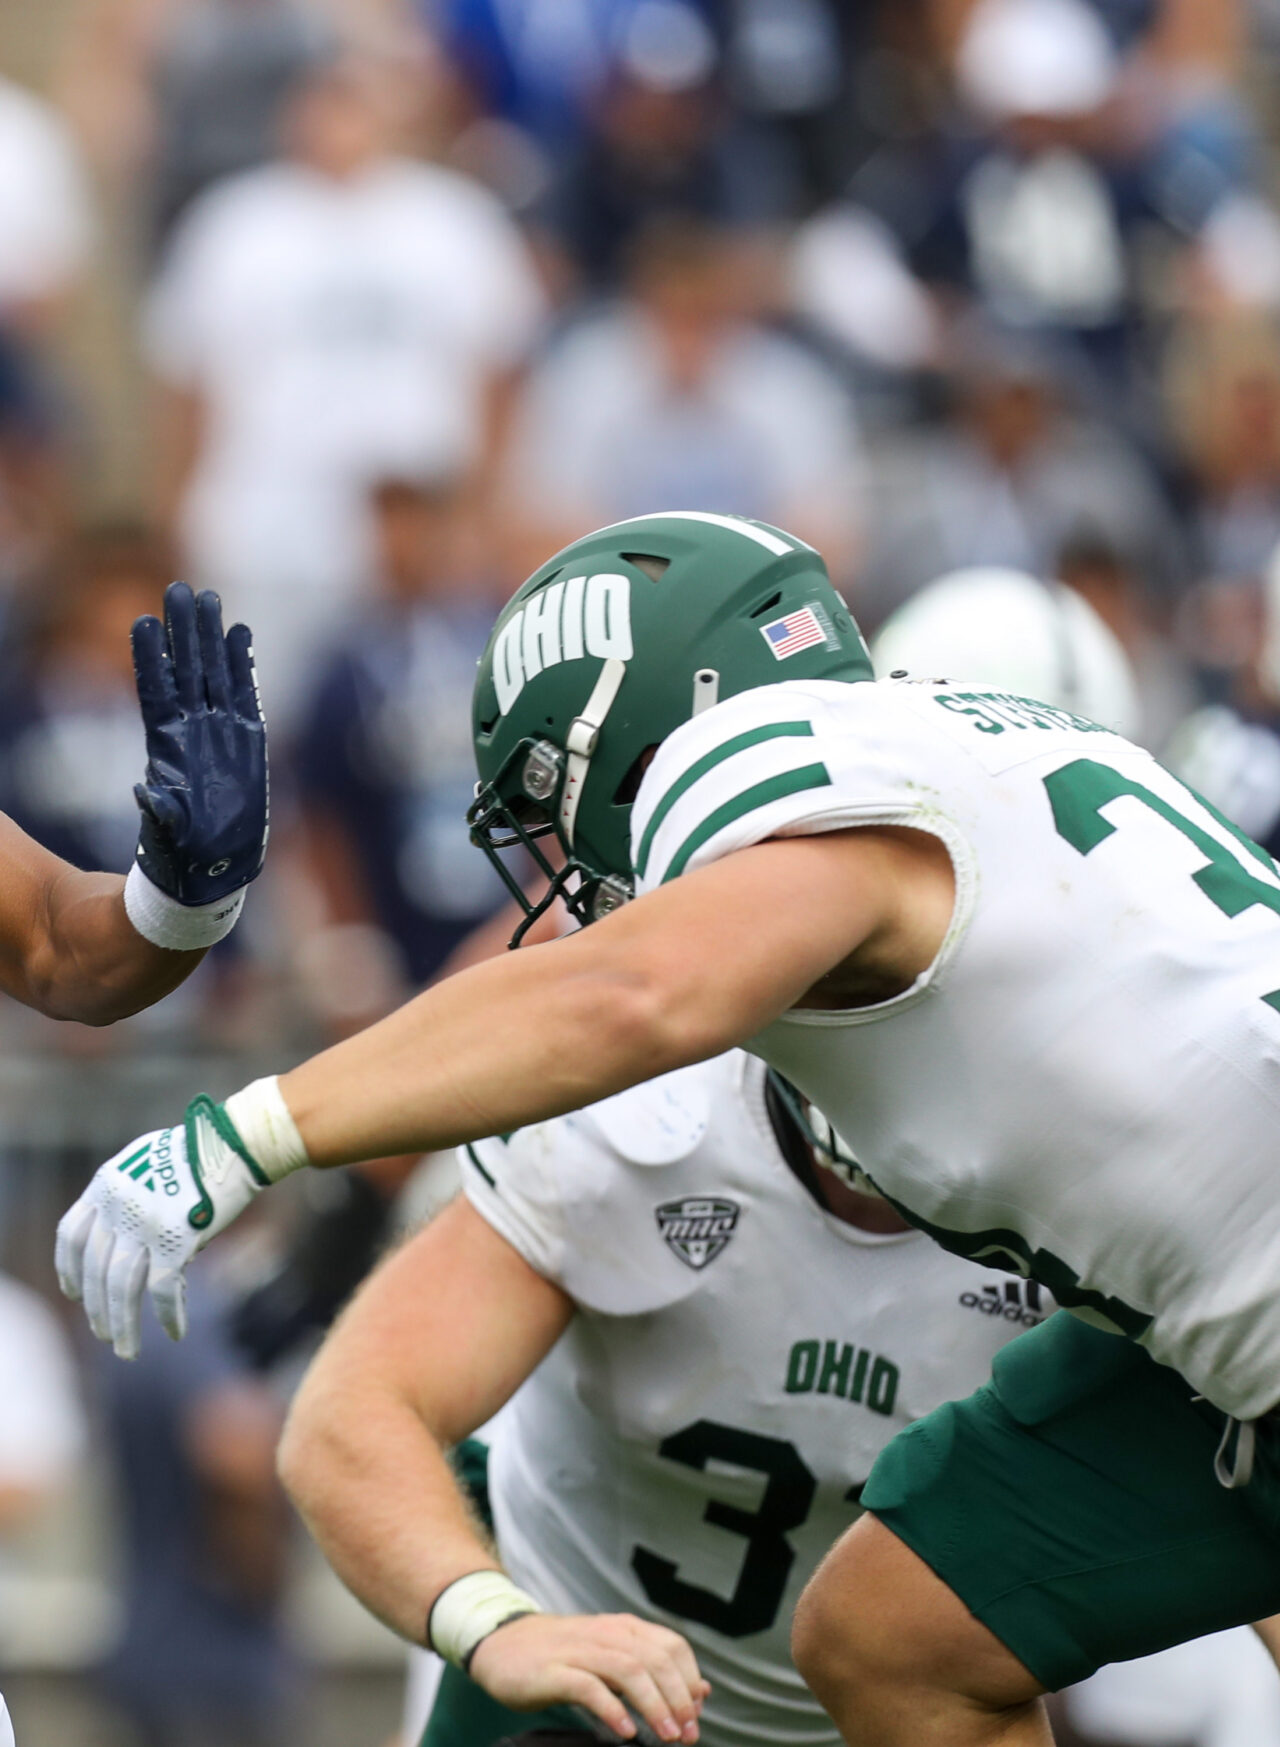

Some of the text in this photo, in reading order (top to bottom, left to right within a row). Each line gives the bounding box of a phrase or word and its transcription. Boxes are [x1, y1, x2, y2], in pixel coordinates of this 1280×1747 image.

[493, 574, 634, 717] OHIO
[959, 1291, 1047, 1328] adida
[784, 1340, 900, 1417] OHIO
[630, 1418, 872, 1639] 3
